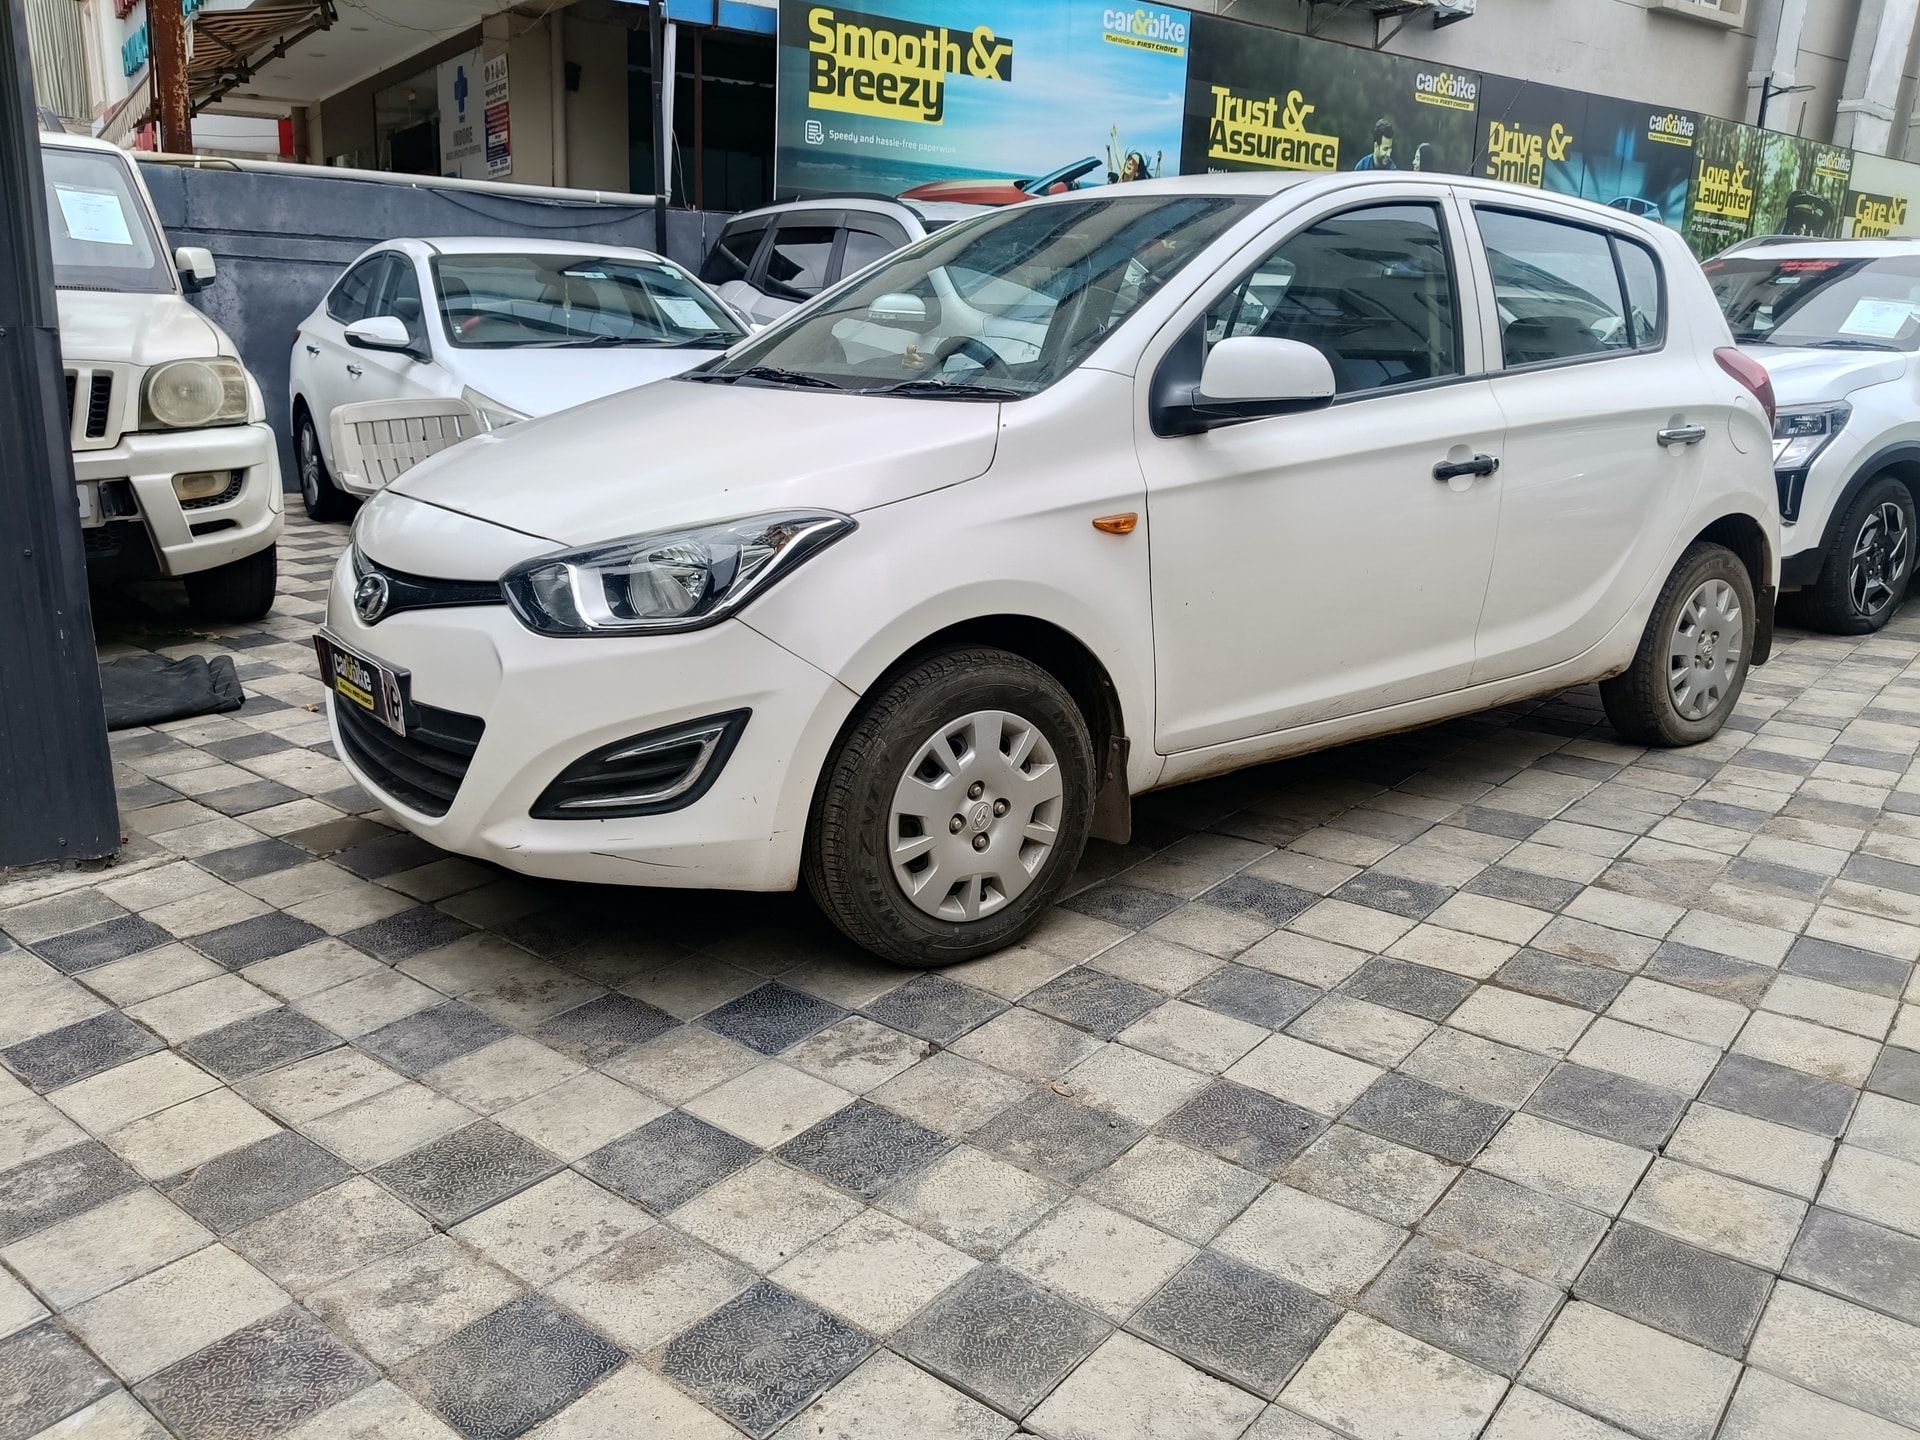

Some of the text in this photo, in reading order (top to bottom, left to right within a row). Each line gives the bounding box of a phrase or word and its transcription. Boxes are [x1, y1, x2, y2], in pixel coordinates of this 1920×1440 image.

[1103, 9, 1186, 43] car&bike
[808, 7, 1013, 80] Smooth &
[1136, 40, 1155, 50] FIRST
[1155, 43, 1178, 54] CHOICE
[809, 52, 944, 122] Breezy
[1416, 72, 1476, 99] car&bike
[1211, 85, 1315, 133] Trust &
[1649, 113, 1694, 136] car&bike
[829, 129, 956, 154] Speedy and hassle-free paperwork
[1209, 119, 1335, 168] Assurance
[1488, 121, 1573, 161] Drive &
[1486, 151, 1541, 185] Smile
[1699, 159, 1750, 188] Love &
[1696, 180, 1751, 212] Laughter
[1855, 193, 1907, 224] Care &
